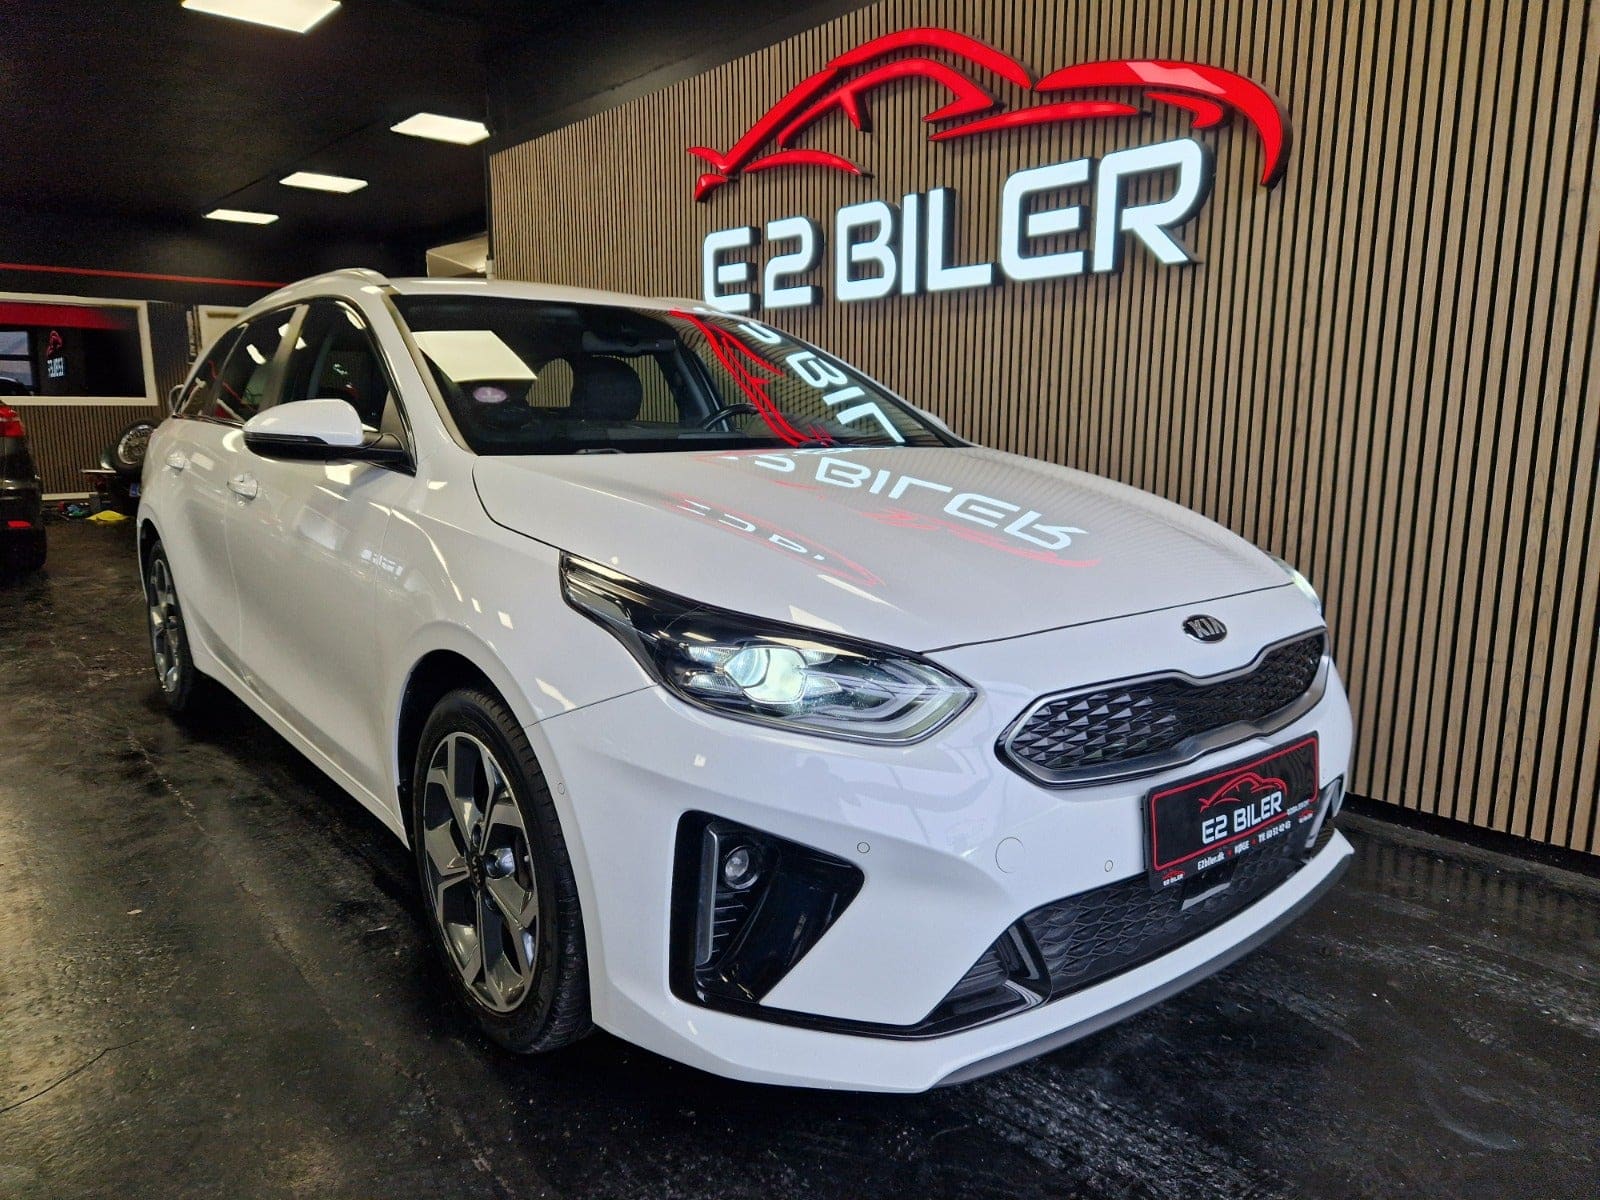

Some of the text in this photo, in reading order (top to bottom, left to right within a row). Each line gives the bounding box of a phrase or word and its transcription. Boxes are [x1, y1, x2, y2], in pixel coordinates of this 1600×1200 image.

[703, 137, 1206, 313] E2 BILER
[1202, 815, 1228, 844] E2
[1233, 791, 1282, 833] BILER
